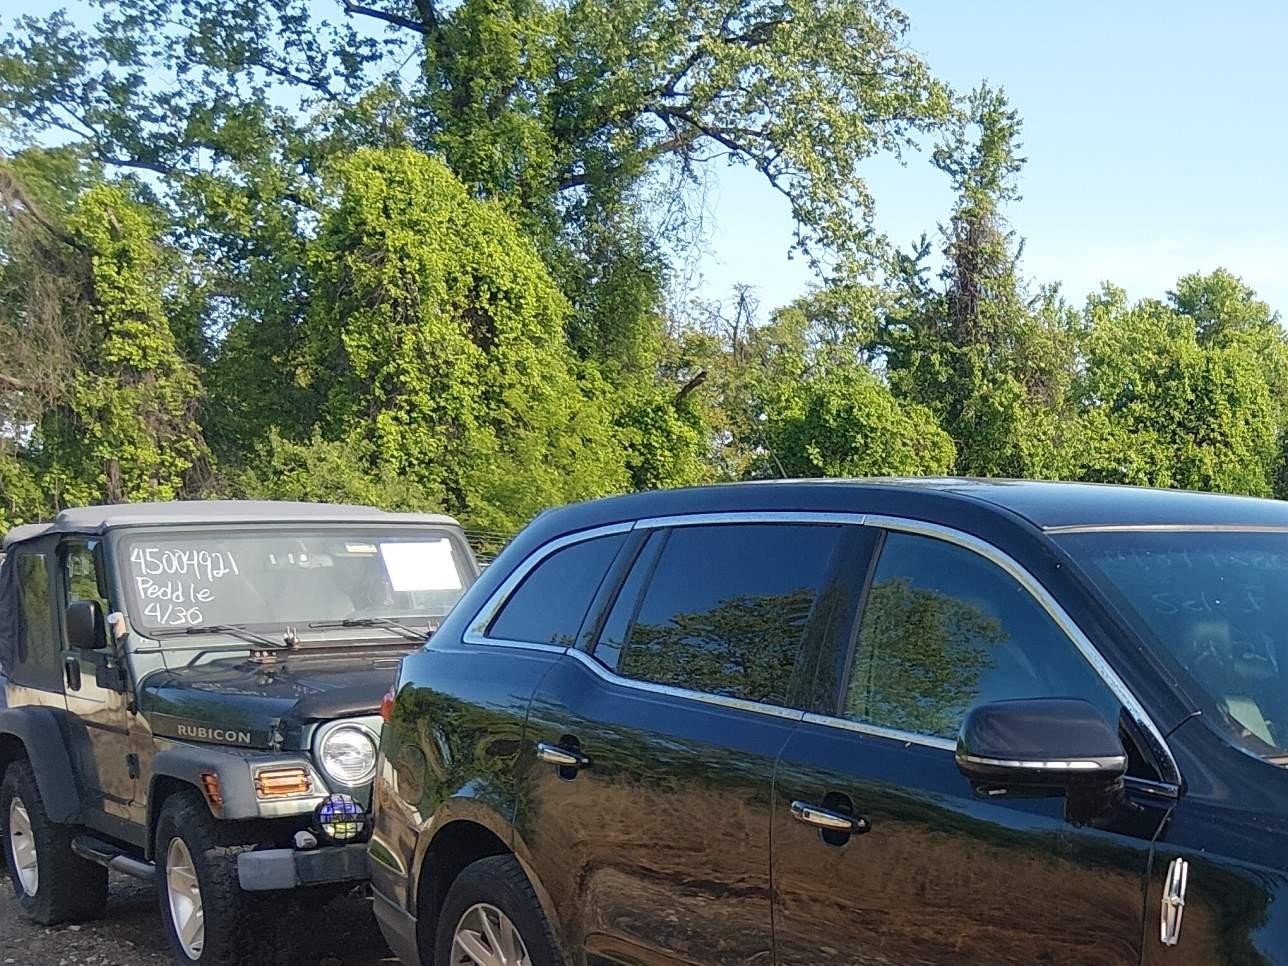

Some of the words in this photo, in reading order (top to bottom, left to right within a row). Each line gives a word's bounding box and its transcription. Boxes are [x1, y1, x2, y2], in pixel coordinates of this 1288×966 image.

[130, 548, 239, 582] 45004921
[136, 576, 215, 603] Peddle
[143, 603, 203, 625] 4/30
[177, 724, 251, 744] RUBICON
